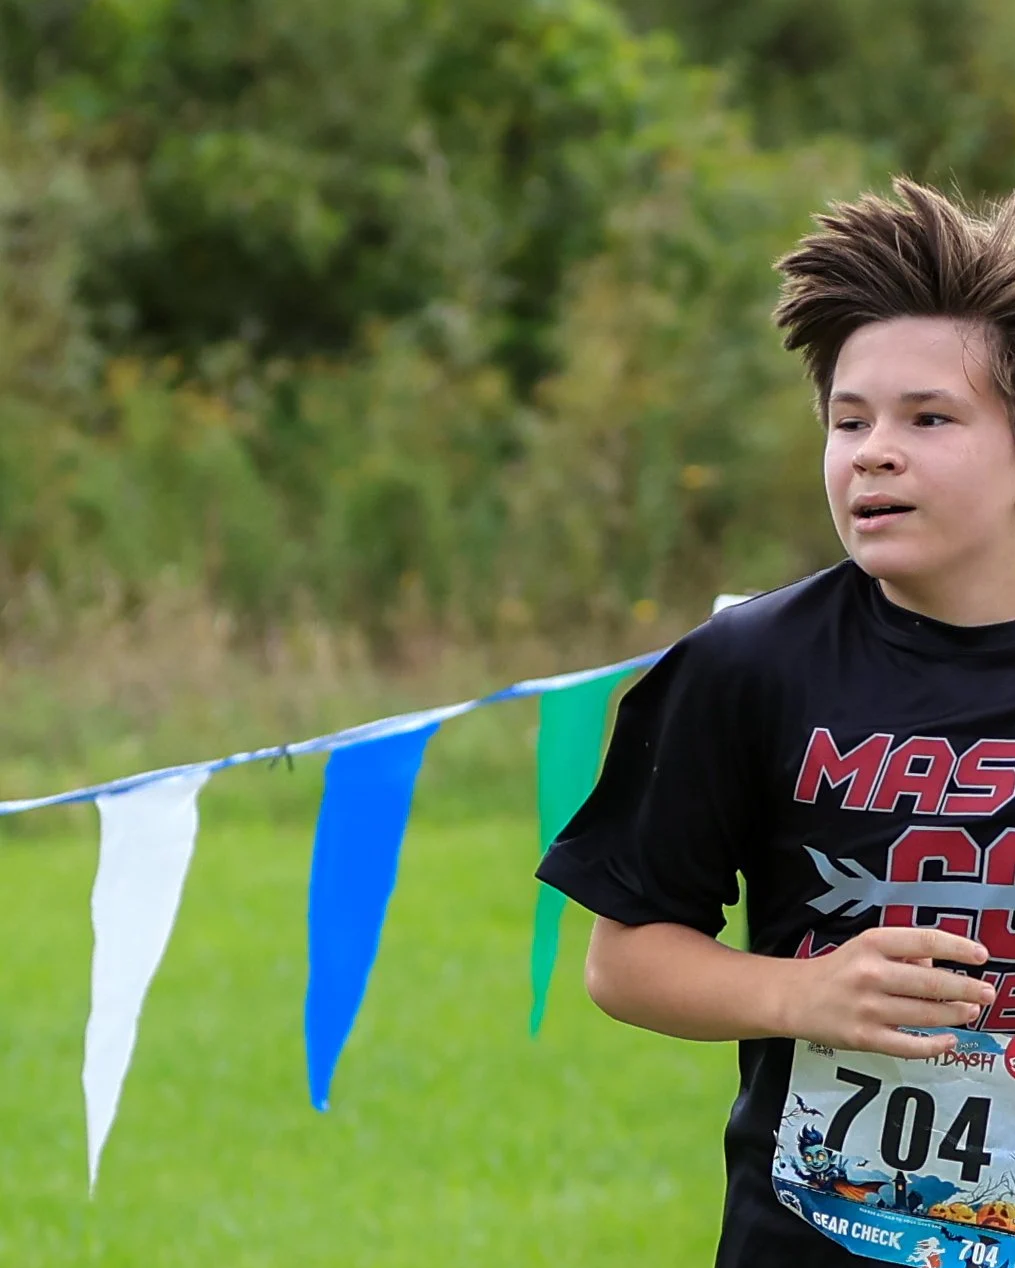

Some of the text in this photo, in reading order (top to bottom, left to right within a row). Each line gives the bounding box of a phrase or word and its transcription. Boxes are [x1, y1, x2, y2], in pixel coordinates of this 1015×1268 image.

[940, 1047, 997, 1074] DASH
[822, 1065, 993, 1184] 704
[812, 1210, 850, 1237] GEAR
[850, 1221, 905, 1251] CHECK
[957, 1238, 1000, 1268] 704
